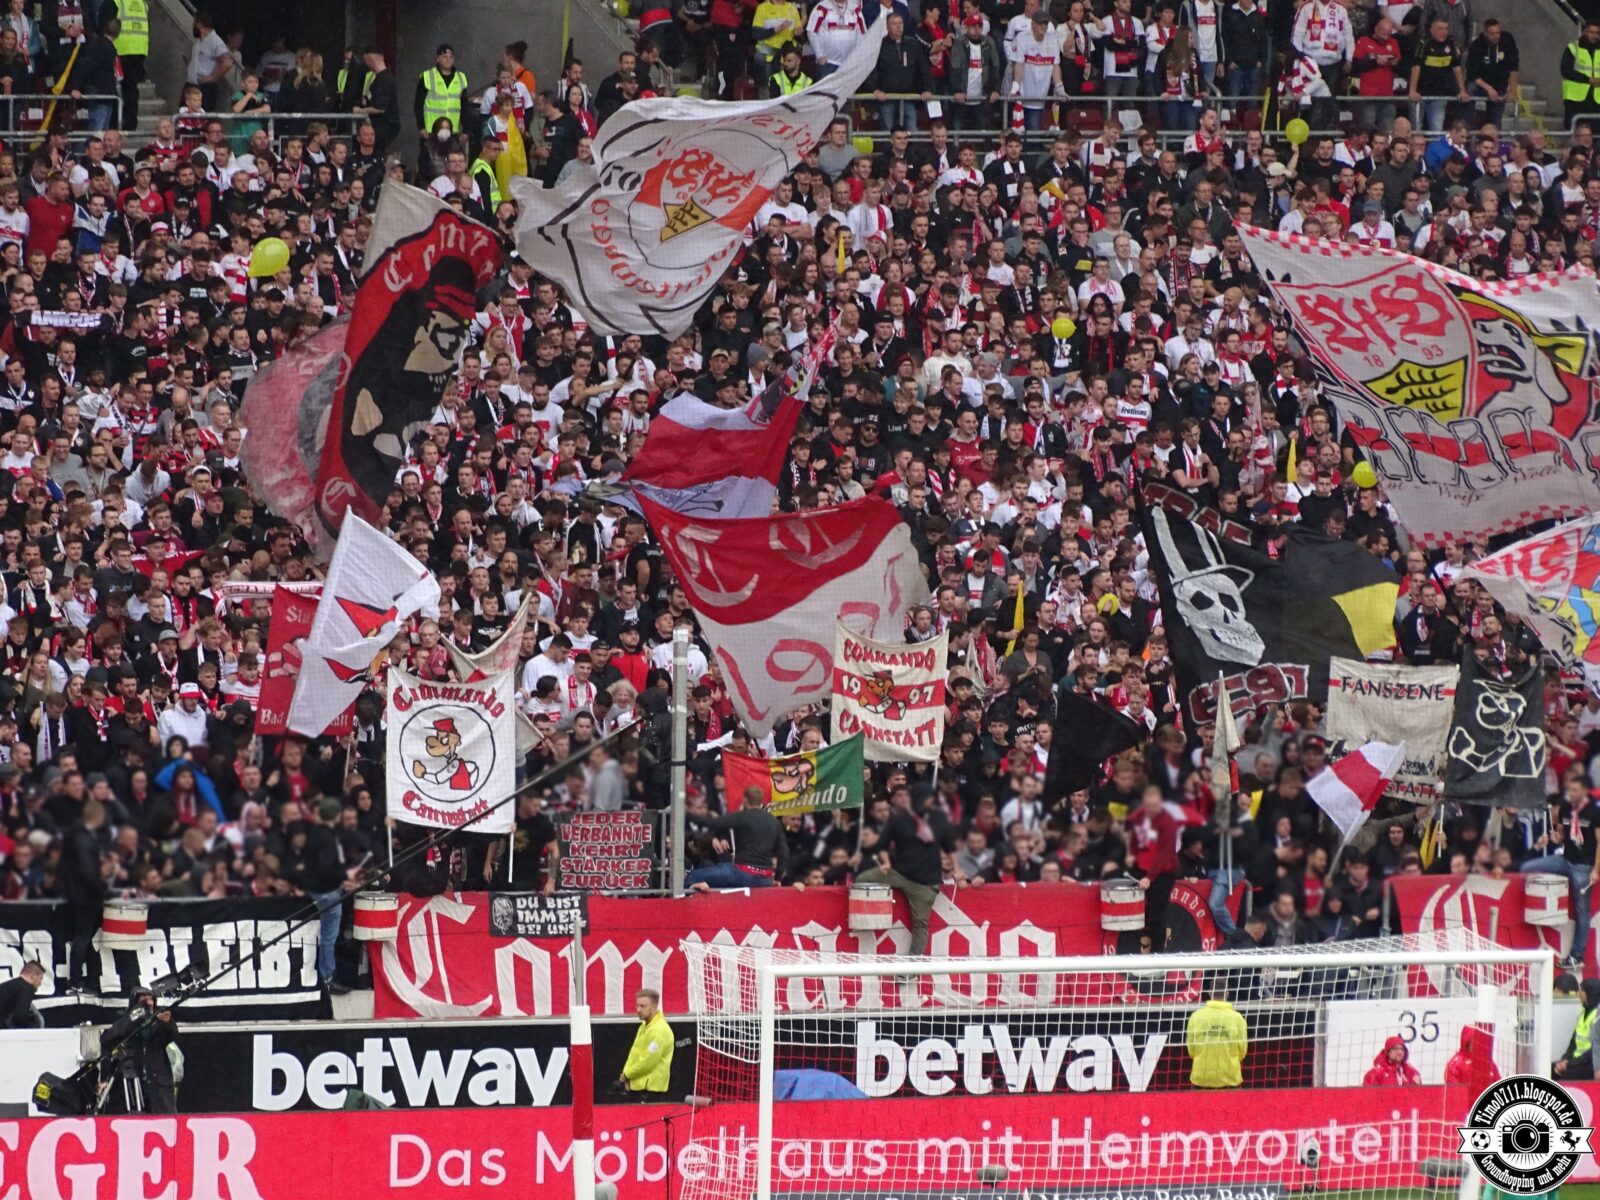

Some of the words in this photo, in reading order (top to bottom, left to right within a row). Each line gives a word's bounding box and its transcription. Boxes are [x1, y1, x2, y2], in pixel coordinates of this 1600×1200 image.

[1363, 353, 1384, 369] 18
[1421, 344, 1445, 360] 93
[843, 638, 936, 673] COMMANDO
[392, 683, 506, 719] Commando
[841, 674, 862, 696] 19
[908, 685, 936, 706] 97
[1340, 676, 1446, 701] FANSZENE
[839, 708, 936, 748] CANNSTATT
[560, 823, 652, 843] VERBANNTE
[571, 810, 643, 825] JEDER
[561, 872, 650, 889] ZURÜCK
[516, 897, 540, 909] DU
[546, 895, 581, 909] BIST
[516, 908, 583, 924] IMMER
[547, 923, 576, 935] UNS
[381, 893, 1058, 1018] Commando
[1398, 1010, 1440, 1043] 35
[252, 1033, 569, 1110] betway
[855, 1021, 1169, 1097] betway
[0, 1117, 263, 1200] GER
[389, 1134, 506, 1187] Das
[535, 1124, 888, 1185] Möbelhaus
[917, 1120, 1022, 1174] mit
[1051, 1109, 1419, 1170] Heimvorteil
